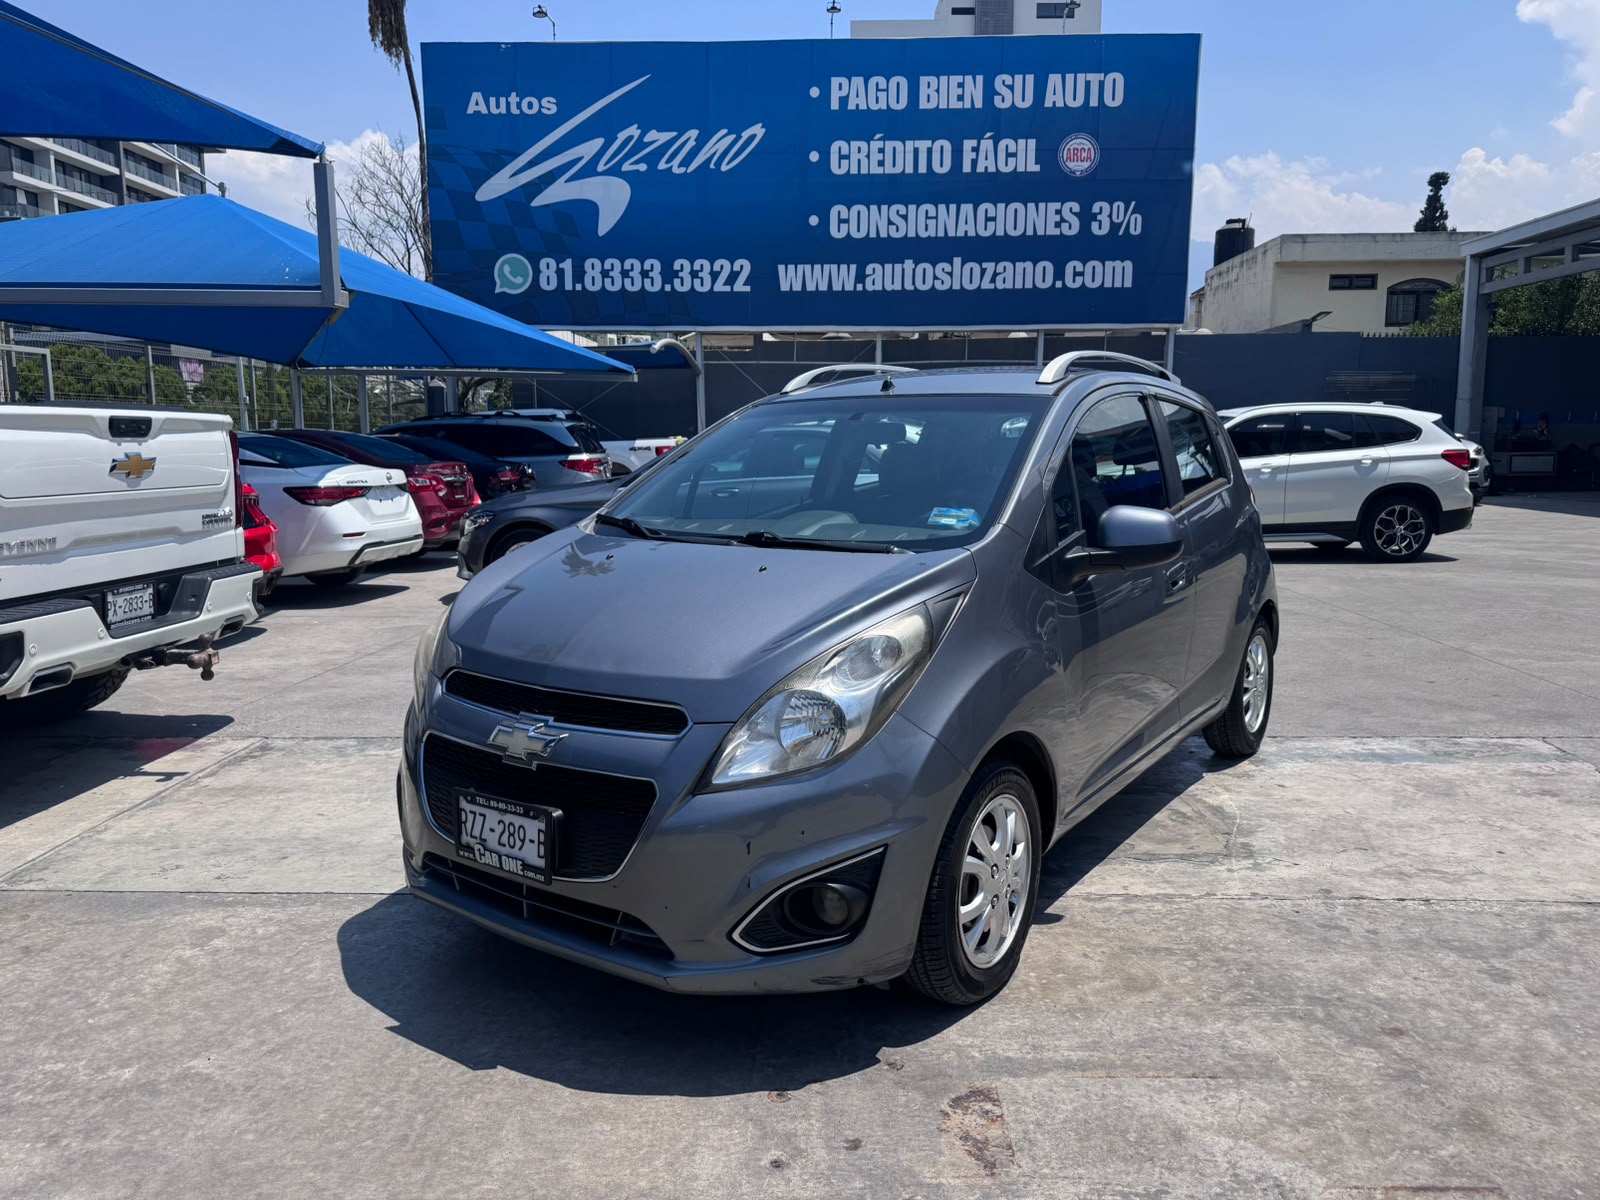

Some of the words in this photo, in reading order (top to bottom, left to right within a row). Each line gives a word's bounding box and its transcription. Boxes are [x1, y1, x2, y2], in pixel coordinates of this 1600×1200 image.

[466, 91, 558, 115] Autos
[830, 75, 909, 111] PAGO
[918, 74, 983, 110] BIEN
[993, 73, 1035, 109] SU
[1044, 72, 1125, 108] AUTO
[830, 133, 952, 175] CRÉDITO
[961, 131, 1041, 174] FÁCIL
[1065, 146, 1093, 163] ARCA
[829, 201, 1081, 239] CONSIGNACIONES
[1090, 200, 1143, 237] 3%
[538, 257, 752, 293] 81.8333.3322
[777, 256, 1134, 292] www.autoslozano.com
[475, 796, 489, 805] TEL:
[473, 842, 500, 868] CAR
[501, 855, 524, 875] ONE
